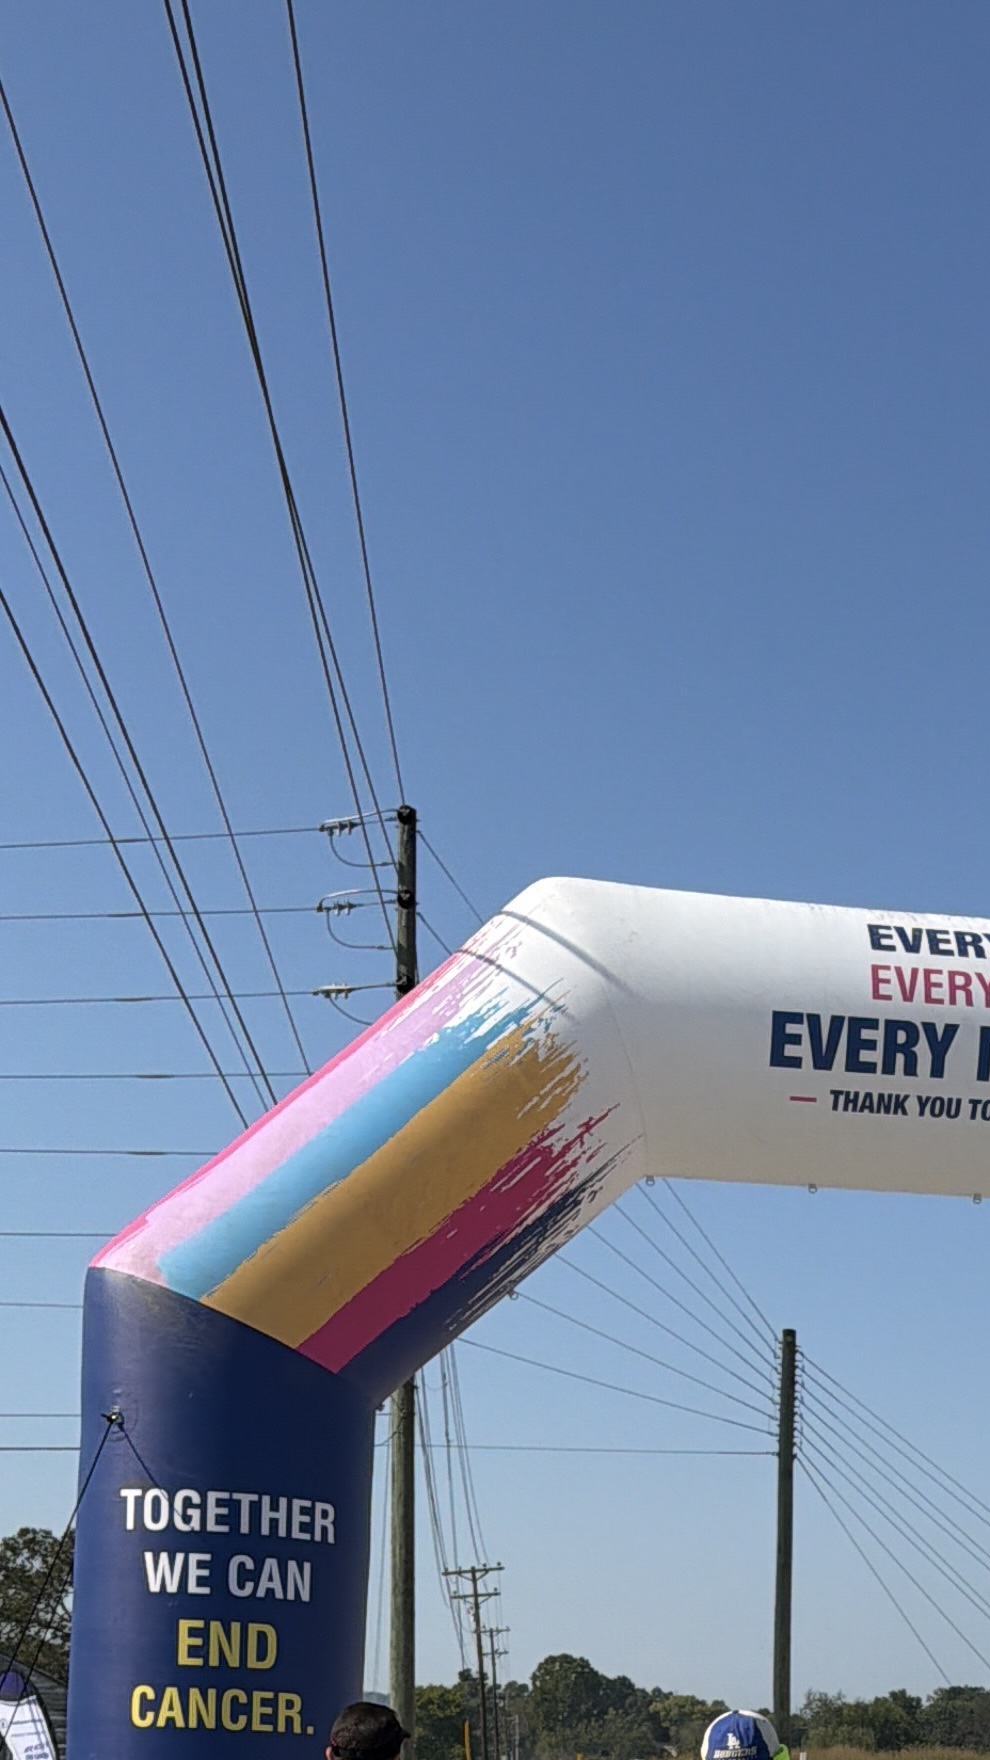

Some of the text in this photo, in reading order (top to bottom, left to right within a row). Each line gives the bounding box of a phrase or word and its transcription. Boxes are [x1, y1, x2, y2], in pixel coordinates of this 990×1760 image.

[769, 1010, 960, 1079] EVERY
[829, 1089, 909, 1117] THANK
[915, 1095, 962, 1120] YOU
[119, 1488, 336, 1544] TOGETHER
[144, 1551, 312, 1602] WE CAN
[177, 1618, 279, 1670] END
[130, 1684, 315, 1735] CANCER.
